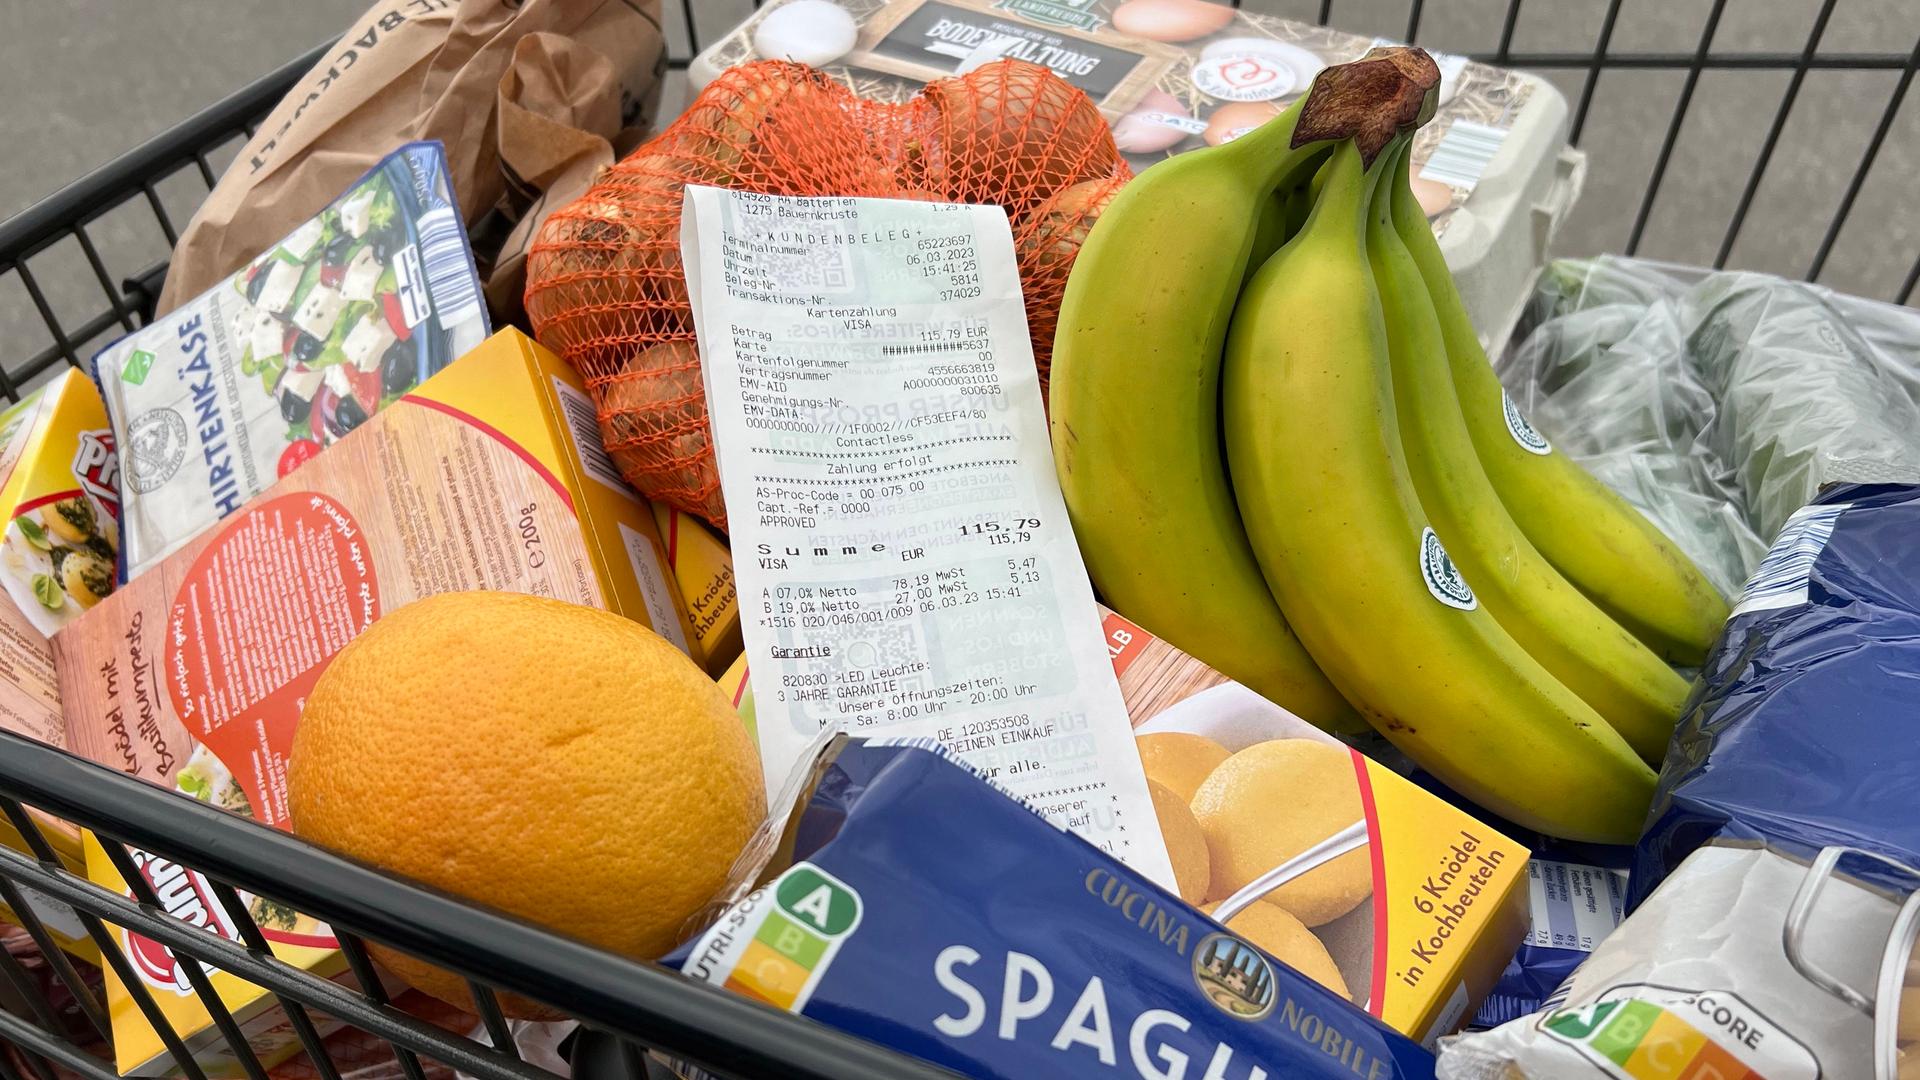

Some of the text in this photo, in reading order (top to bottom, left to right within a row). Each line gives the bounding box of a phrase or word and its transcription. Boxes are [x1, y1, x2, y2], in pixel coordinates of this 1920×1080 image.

[925, 19, 1101, 76] BODEALTUNG
[249, 10, 406, 175] BACKWELT
[745, 204, 858, 219] 1275 Bauernkruste
[722, 231, 972, 256] Terminalnummer 65223697
[722, 245, 975, 266] Datum 06.03.2023
[723, 259, 977, 278] Uhrzeit 15:41:25
[725, 271, 979, 291] Beleg-Nr. 5814
[726, 285, 981, 305] Transaktions-Nr. 374029
[806, 307, 897, 319] Kartenzahlung
[844, 319, 872, 330] VISA
[731, 324, 988, 342] Betrag 115,79 EUR
[733, 337, 767, 352] Karte
[735, 351, 849, 369] Kartenfolgenummer
[978, 351, 993, 361] 00
[738, 363, 995, 382] Vertragsnummer 4556663819
[739, 373, 998, 393] EMV-AID A0000000031010
[741, 384, 1001, 409] Genehmigungs-Nr. 800635
[178, 312, 241, 521] HIRTENKÄSE
[743, 404, 804, 420] EMV-DATA:
[836, 433, 913, 448] Contactless
[827, 453, 933, 475] Zahlung erfolgt
[756, 486, 839, 501] AS-Proc-Code
[860, 488, 875, 499] 00
[881, 484, 903, 498] 075
[909, 480, 925, 492] 00
[840, 502, 871, 514] 0000
[519, 502, 543, 548] 200g
[760, 515, 816, 529] APPROVED
[350, 540, 366, 577] unter
[757, 543, 886, 556] Summe
[758, 557, 788, 570] VISA
[901, 547, 925, 562] EUR
[988, 532, 1031, 546] 115,79
[692, 563, 736, 613] Knödel
[762, 557, 1037, 601] A 07,0% Netto 78,19 MwSt 5,47
[764, 571, 1040, 615] B 19,0% Netto 27,00 MwSt 5,13
[696, 585, 736, 641] chbeutel
[802, 605, 913, 628] 020/046/001/009
[919, 592, 979, 613] 06.03.23
[985, 586, 1022, 600] 15:41
[771, 645, 832, 659] Garantie
[173, 649, 190, 697] einfach
[782, 673, 828, 687] 820830
[871, 661, 931, 680] Leuchte:
[125, 610, 175, 778] Basilikumpesto
[777, 679, 898, 702] 3 JAHRE GARANTIE
[100, 657, 143, 777] Knödel mit
[839, 699, 885, 714] Unsere
[857, 715, 879, 726] Sa:
[887, 705, 918, 721] 8:00
[925, 700, 948, 714] Uhr
[969, 687, 1009, 706] 20:00
[1014, 682, 1037, 696] Uhr
[938, 713, 1030, 742] DE 120353508
[948, 724, 1055, 754] DEINEN EINKAUF
[1009, 759, 1047, 775] alle.
[1039, 799, 1088, 815] nserer
[1068, 814, 1092, 828] auf
[1414, 830, 1481, 914] 6 Knödel
[791, 883, 833, 929] A
[1084, 867, 1190, 955] CUCINA
[1395, 849, 1505, 988] in Kochbeuteln
[690, 883, 772, 982] UTRI-SCO
[775, 925, 805, 955] B
[757, 958, 788, 987] C
[1279, 997, 1392, 1080] NOBILE
[1607, 1012, 1643, 1045] B
[1647, 1034, 1684, 1073] C
